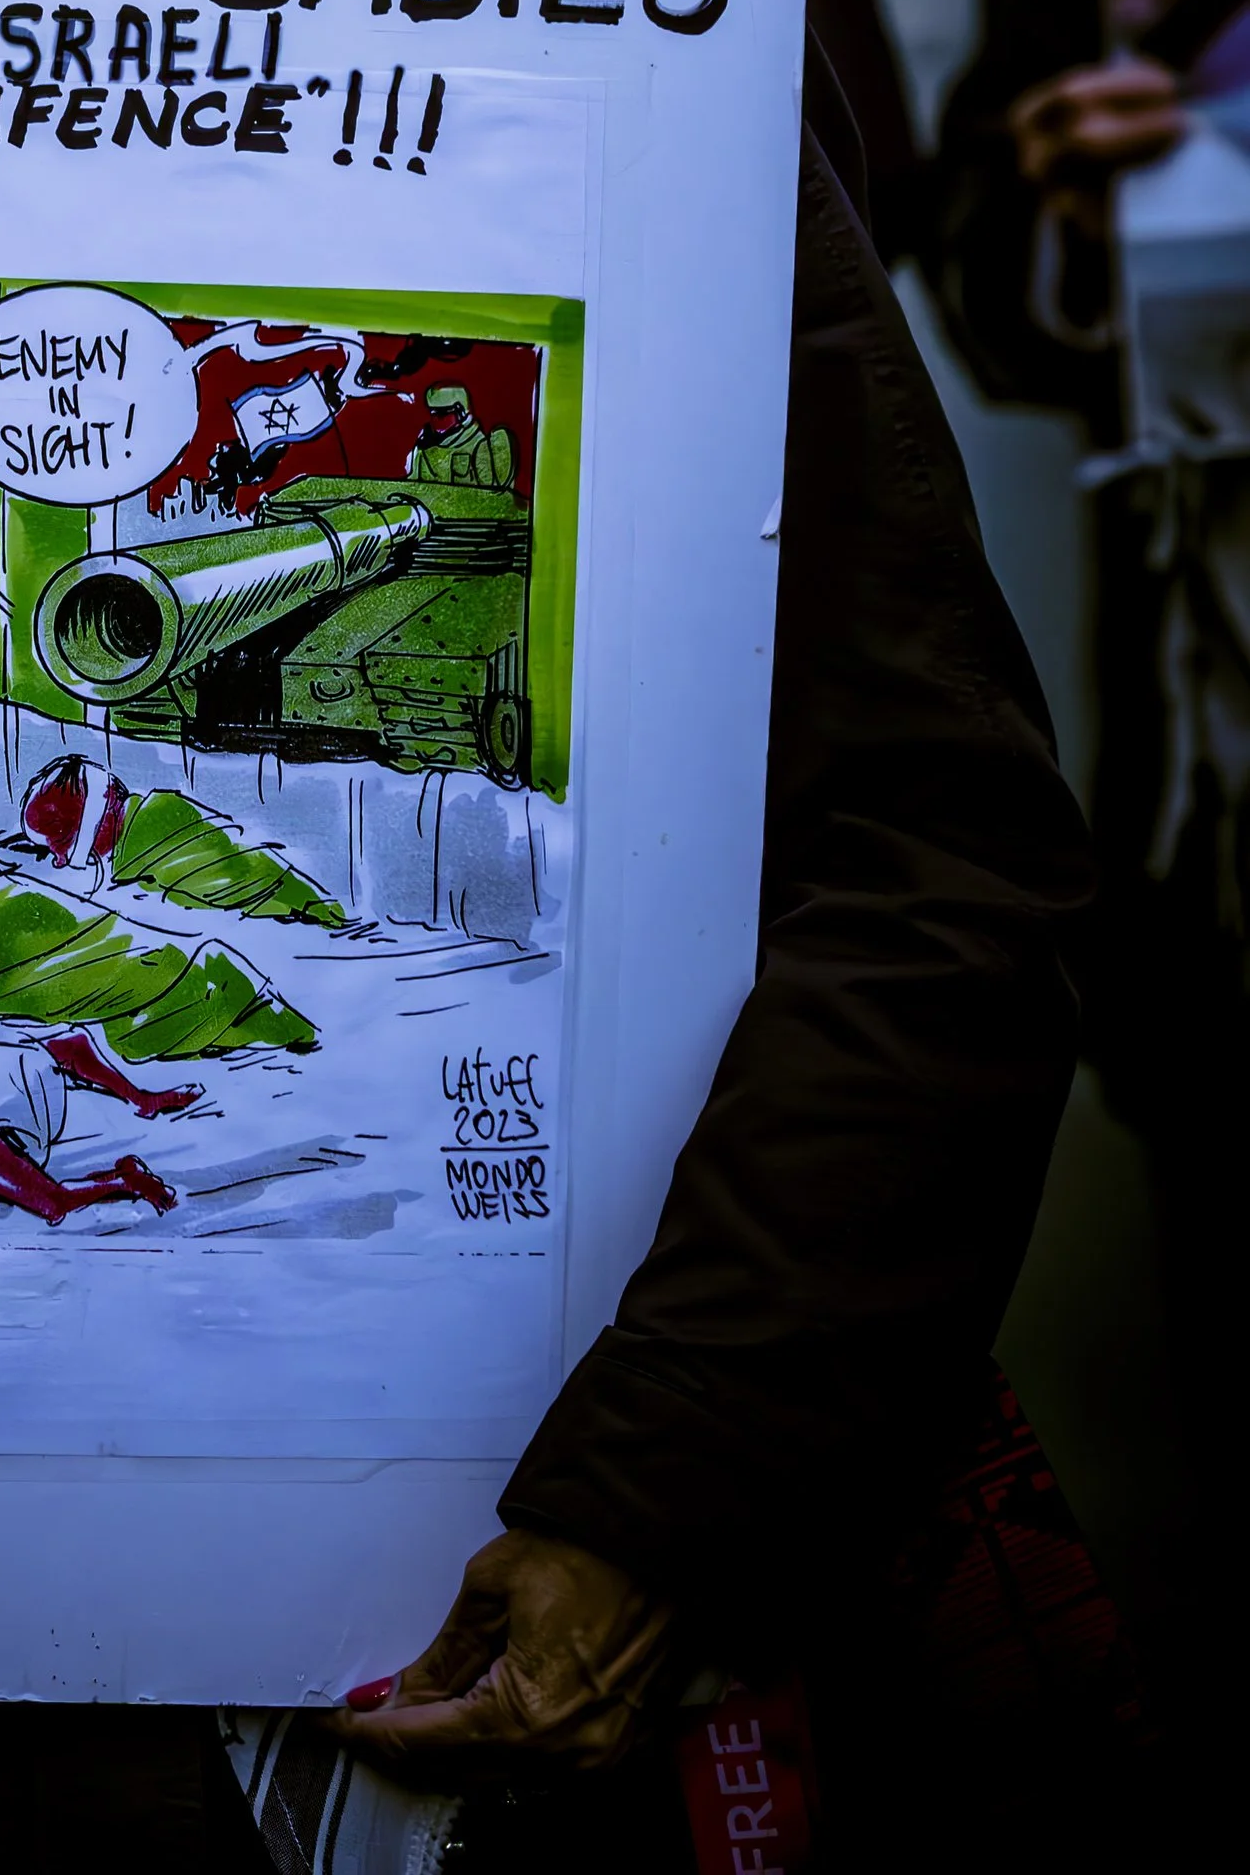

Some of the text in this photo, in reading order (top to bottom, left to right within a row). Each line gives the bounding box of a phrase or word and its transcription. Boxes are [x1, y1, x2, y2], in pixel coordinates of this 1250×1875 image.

[47, 384, 82, 419] IN
[0, 403, 136, 477] SIGHT!
[453, 1105, 540, 1146] 2023
[445, 1155, 546, 1192] MONDO
[450, 1188, 551, 1225] WEISS
[706, 1718, 785, 1875] FREE
